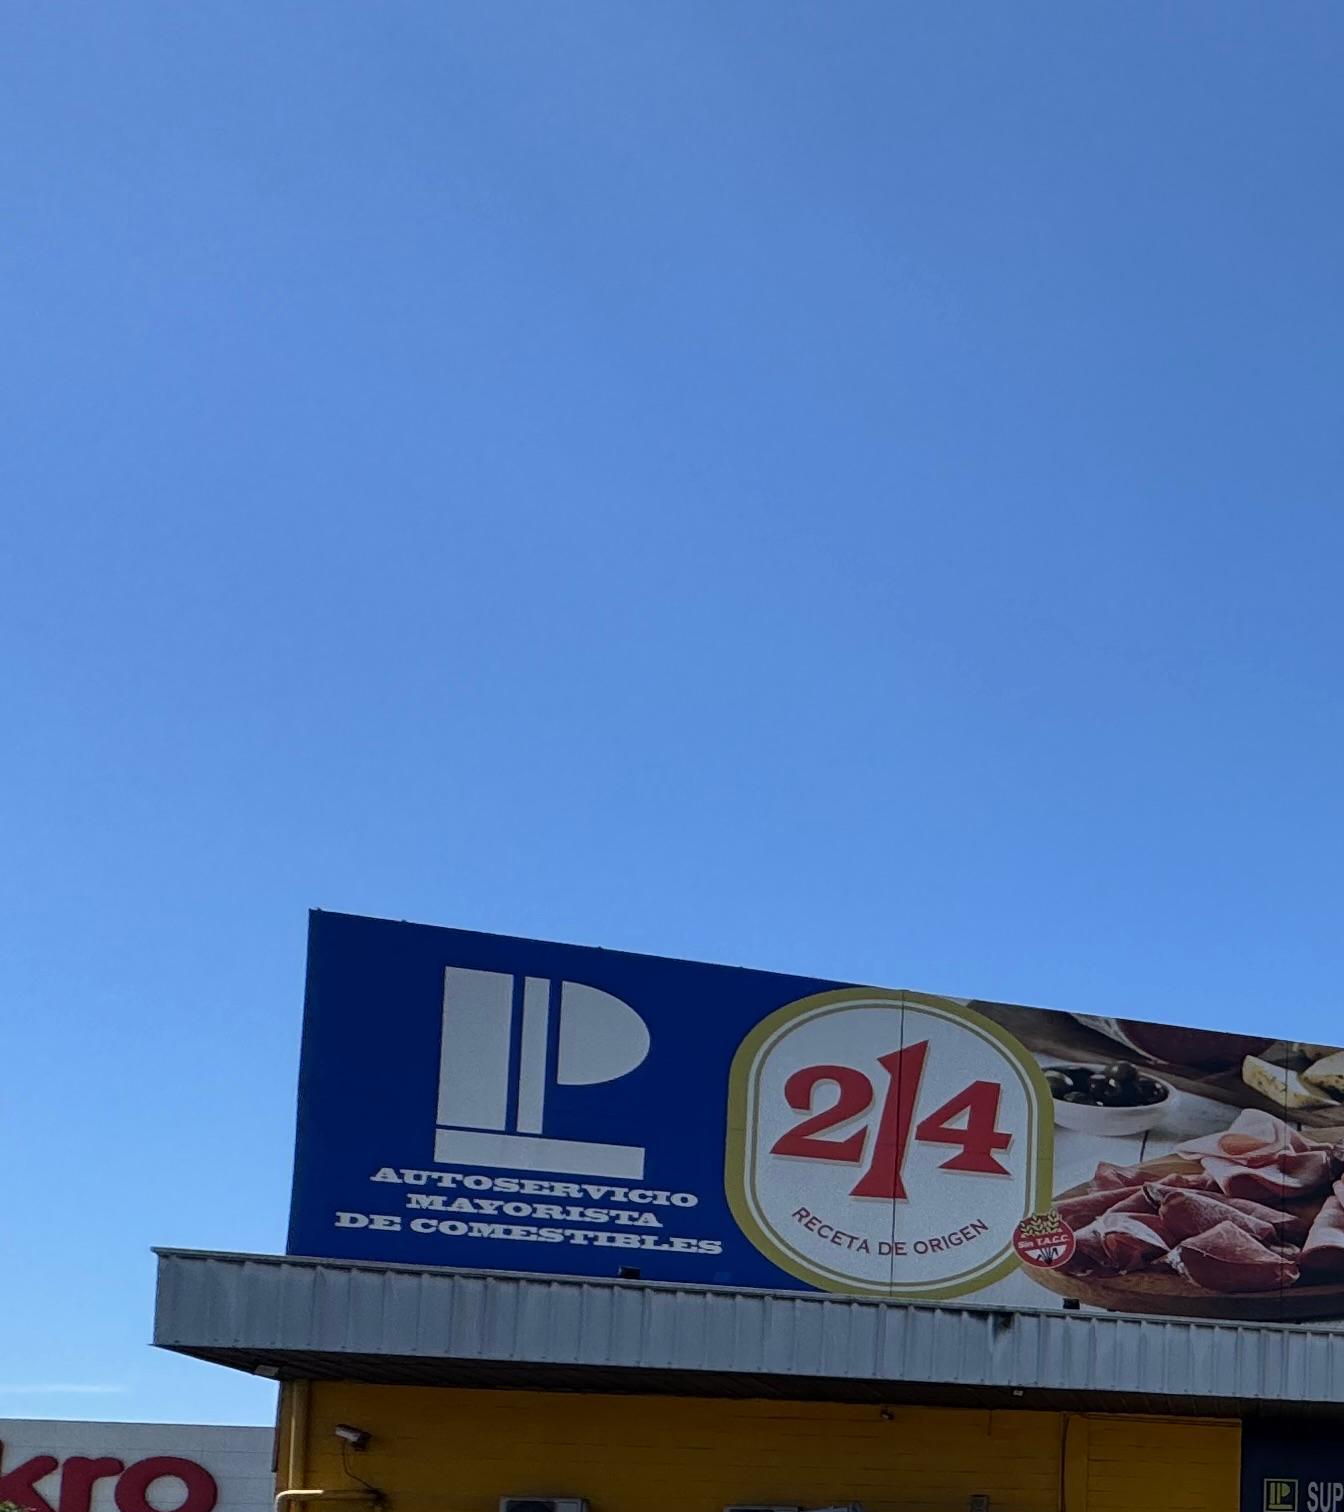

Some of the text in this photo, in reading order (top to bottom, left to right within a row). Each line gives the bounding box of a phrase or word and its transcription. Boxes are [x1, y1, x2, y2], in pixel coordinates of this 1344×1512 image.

[370, 1167, 698, 1207] AUTOSERVICIO
[406, 1194, 663, 1228] MAYORISTA
[792, 1207, 989, 1255] RECETA DE ORIGEN
[335, 1211, 723, 1255] DE COMESTIBLES
